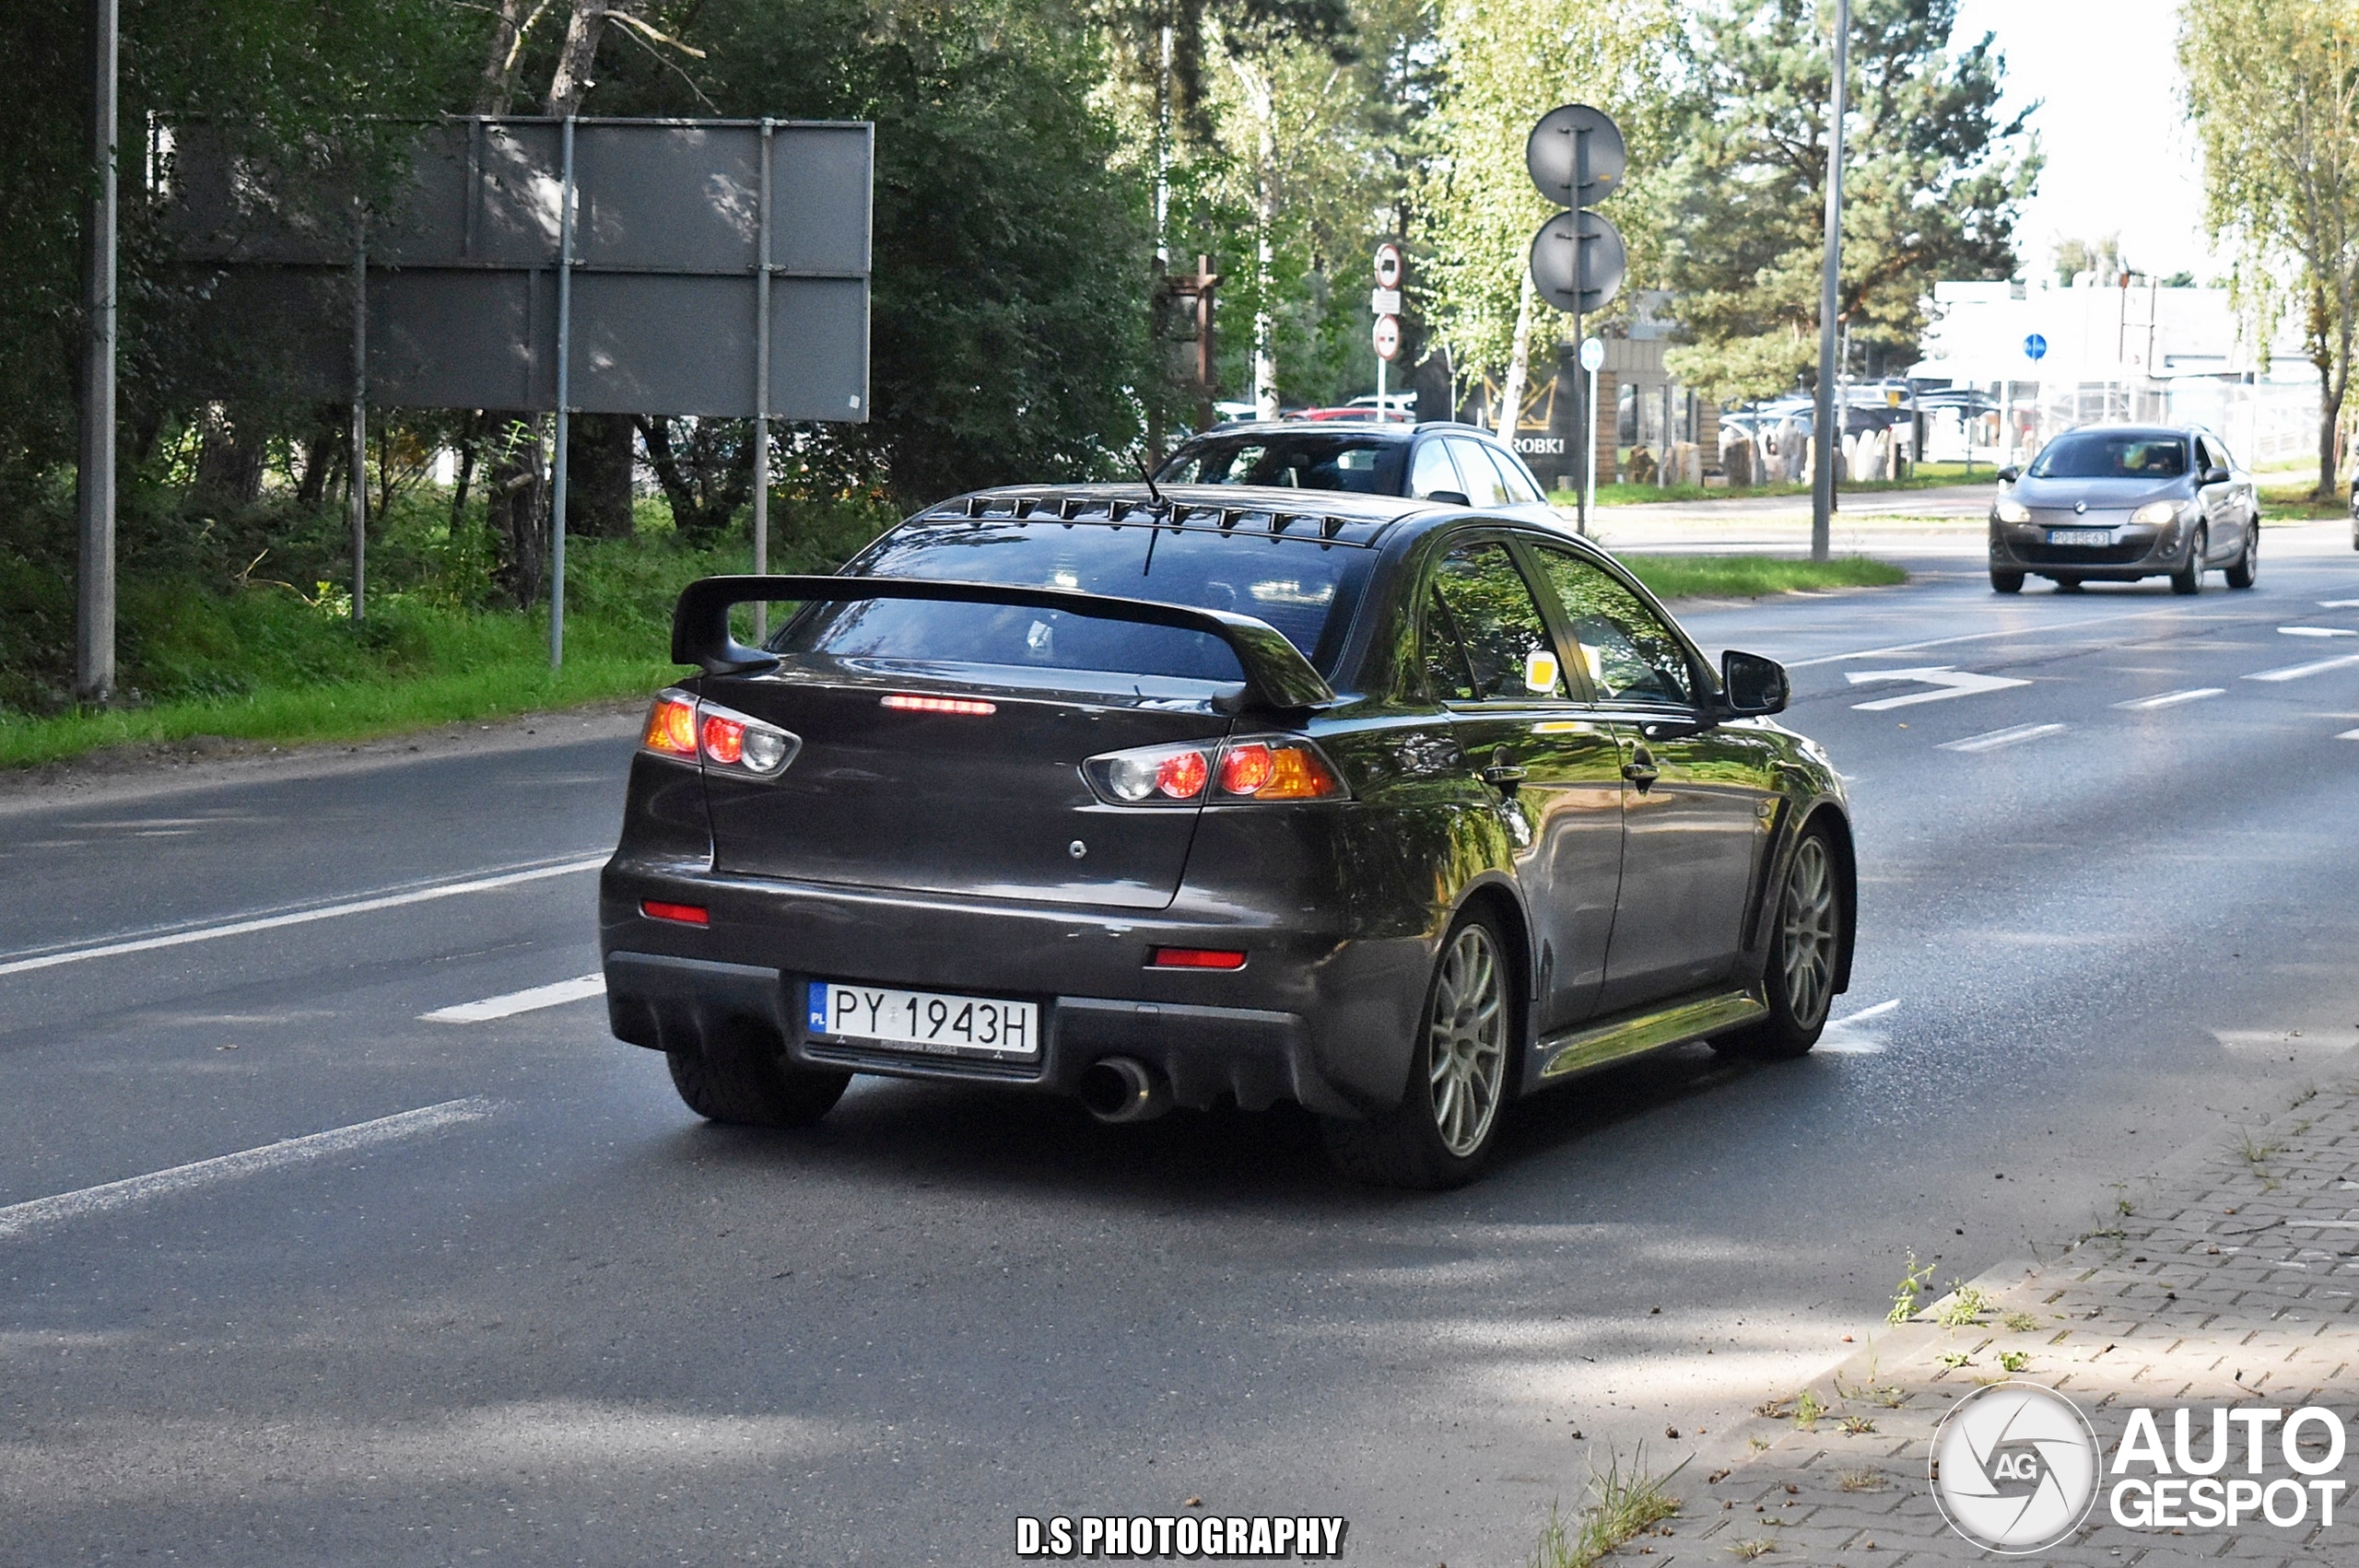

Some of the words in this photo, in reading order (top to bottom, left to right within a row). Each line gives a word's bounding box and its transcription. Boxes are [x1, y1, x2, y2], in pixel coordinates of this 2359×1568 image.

[811, 1012, 826, 1025] PL
[836, 989, 885, 1033] PY
[906, 997, 1026, 1047] 1943H
